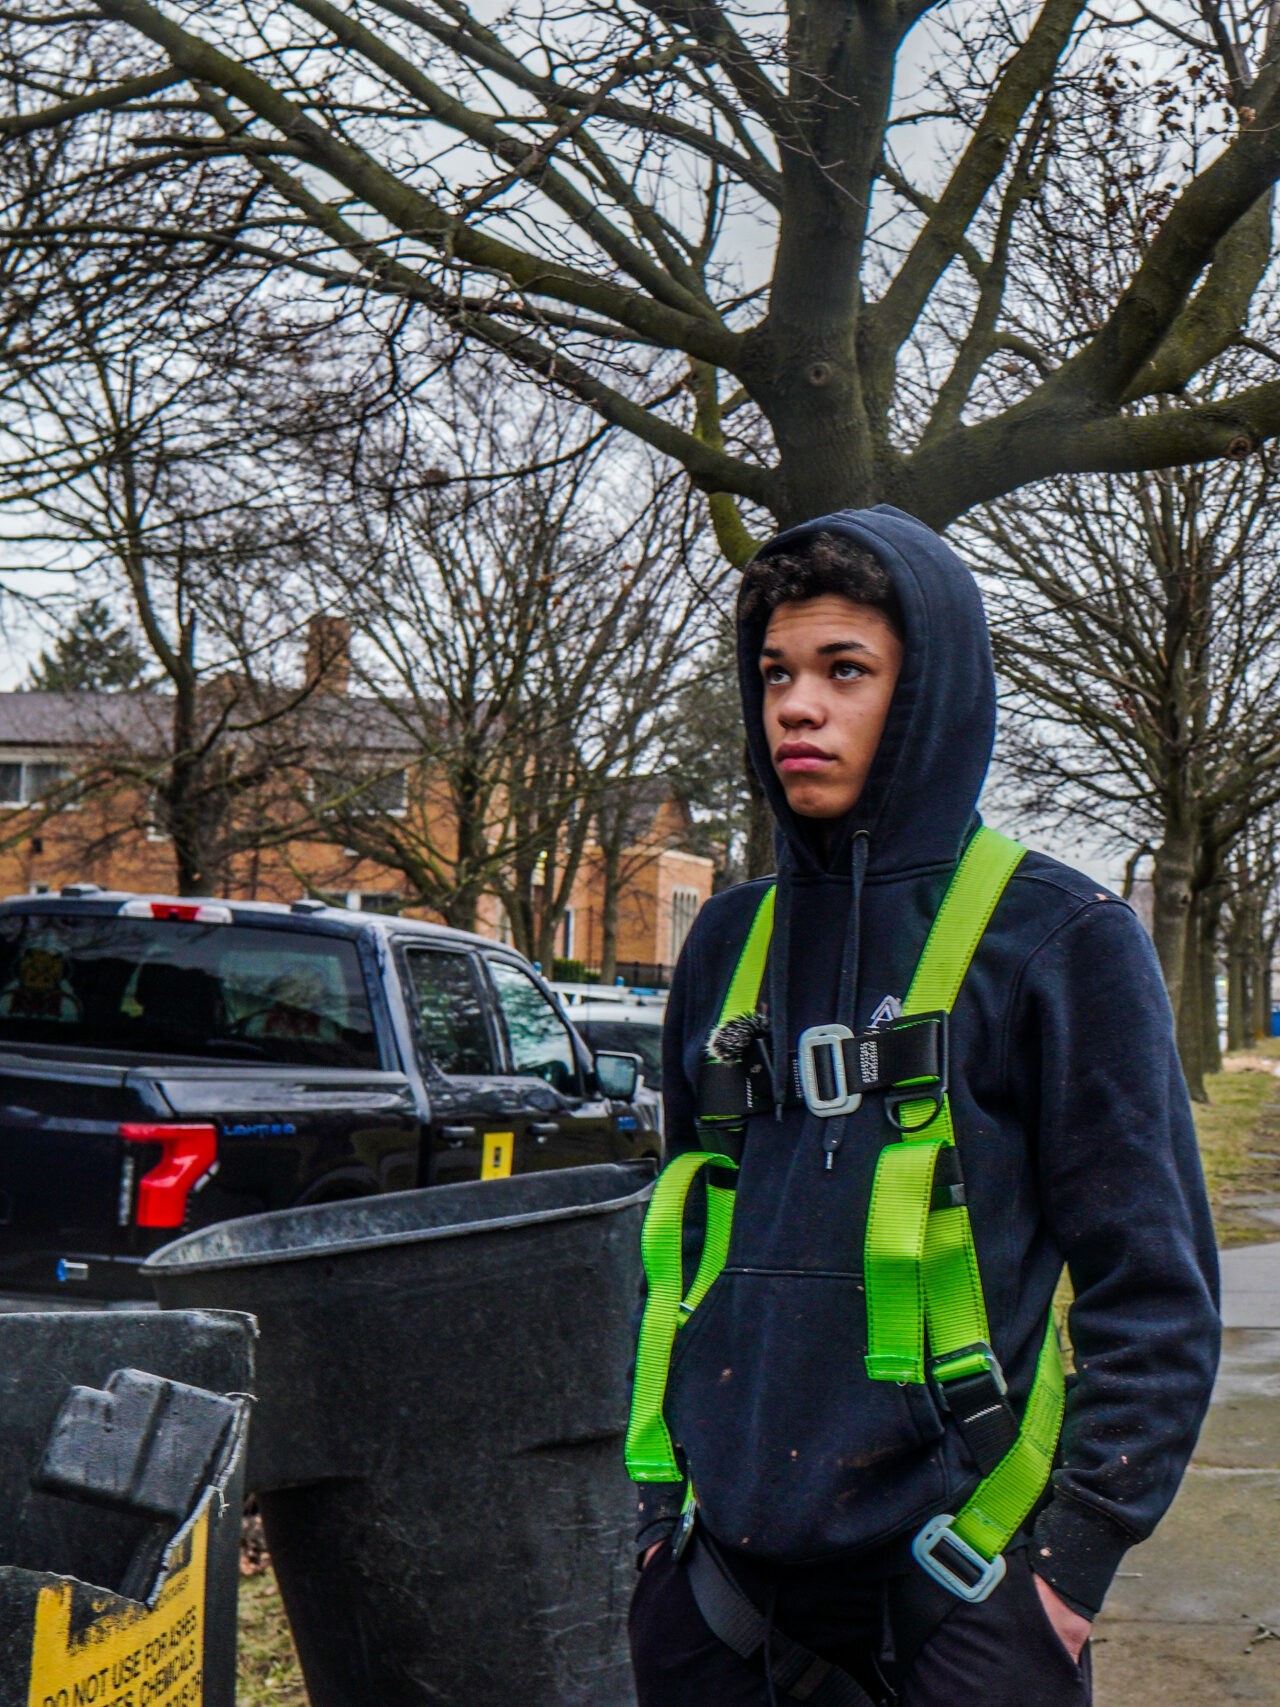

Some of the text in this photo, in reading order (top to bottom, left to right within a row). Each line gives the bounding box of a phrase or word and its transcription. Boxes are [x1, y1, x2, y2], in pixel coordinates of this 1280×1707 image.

[74, 1669, 108, 1706] NOT
[112, 1650, 140, 1689] USE
[145, 1632, 168, 1671] FOR
